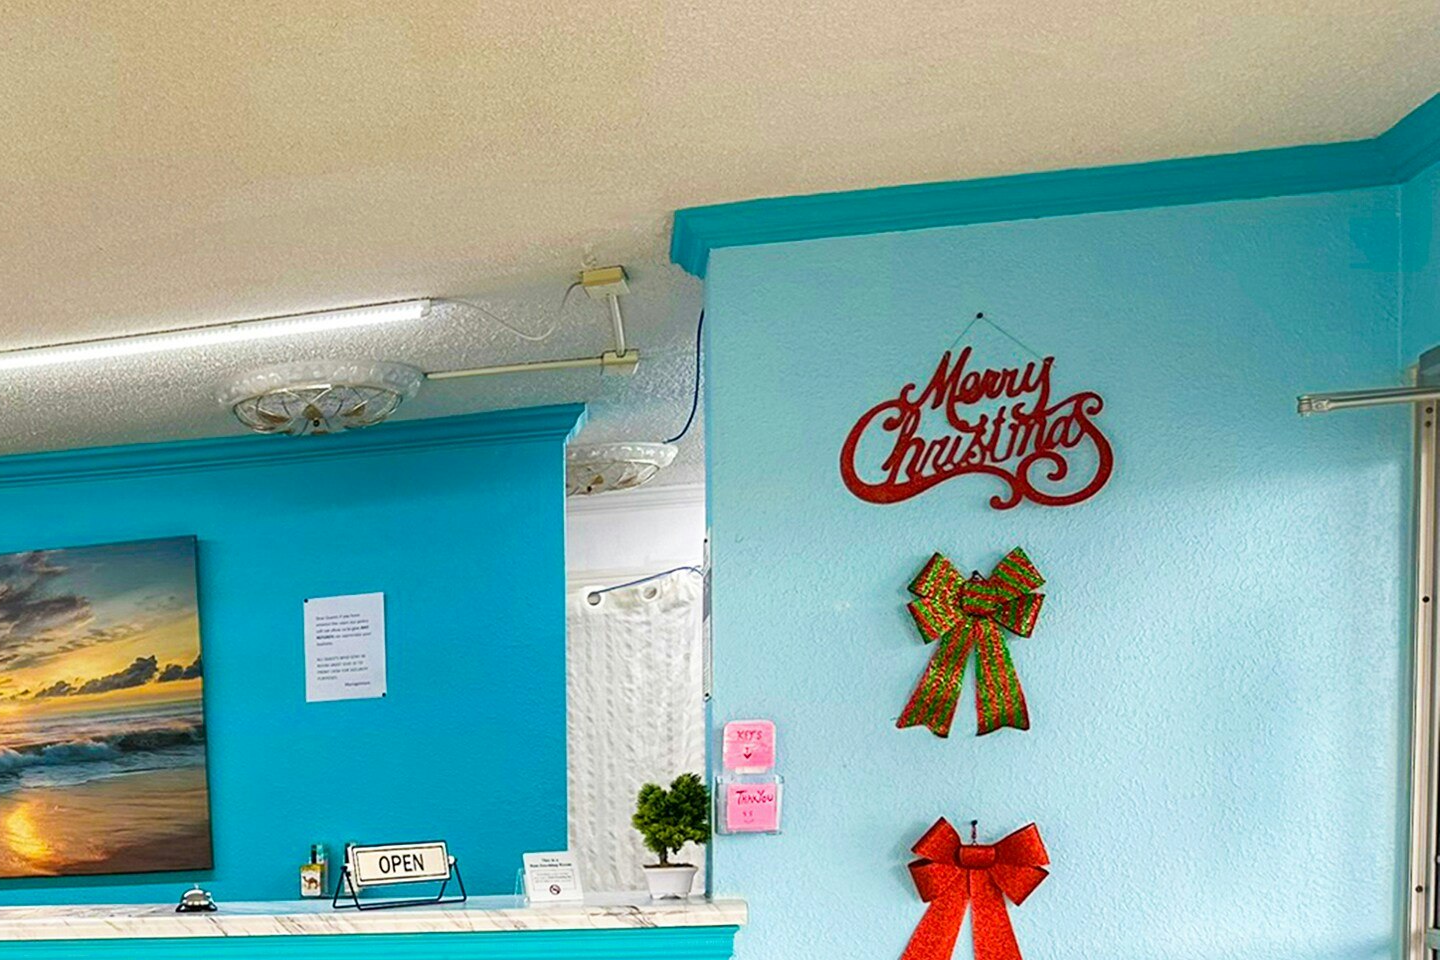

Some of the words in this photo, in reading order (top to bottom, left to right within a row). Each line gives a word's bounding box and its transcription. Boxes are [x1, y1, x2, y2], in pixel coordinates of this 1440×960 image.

[899, 345, 1056, 434] Merry
[839, 390, 1115, 511] Christmas
[378, 853, 425, 874] OPEN
